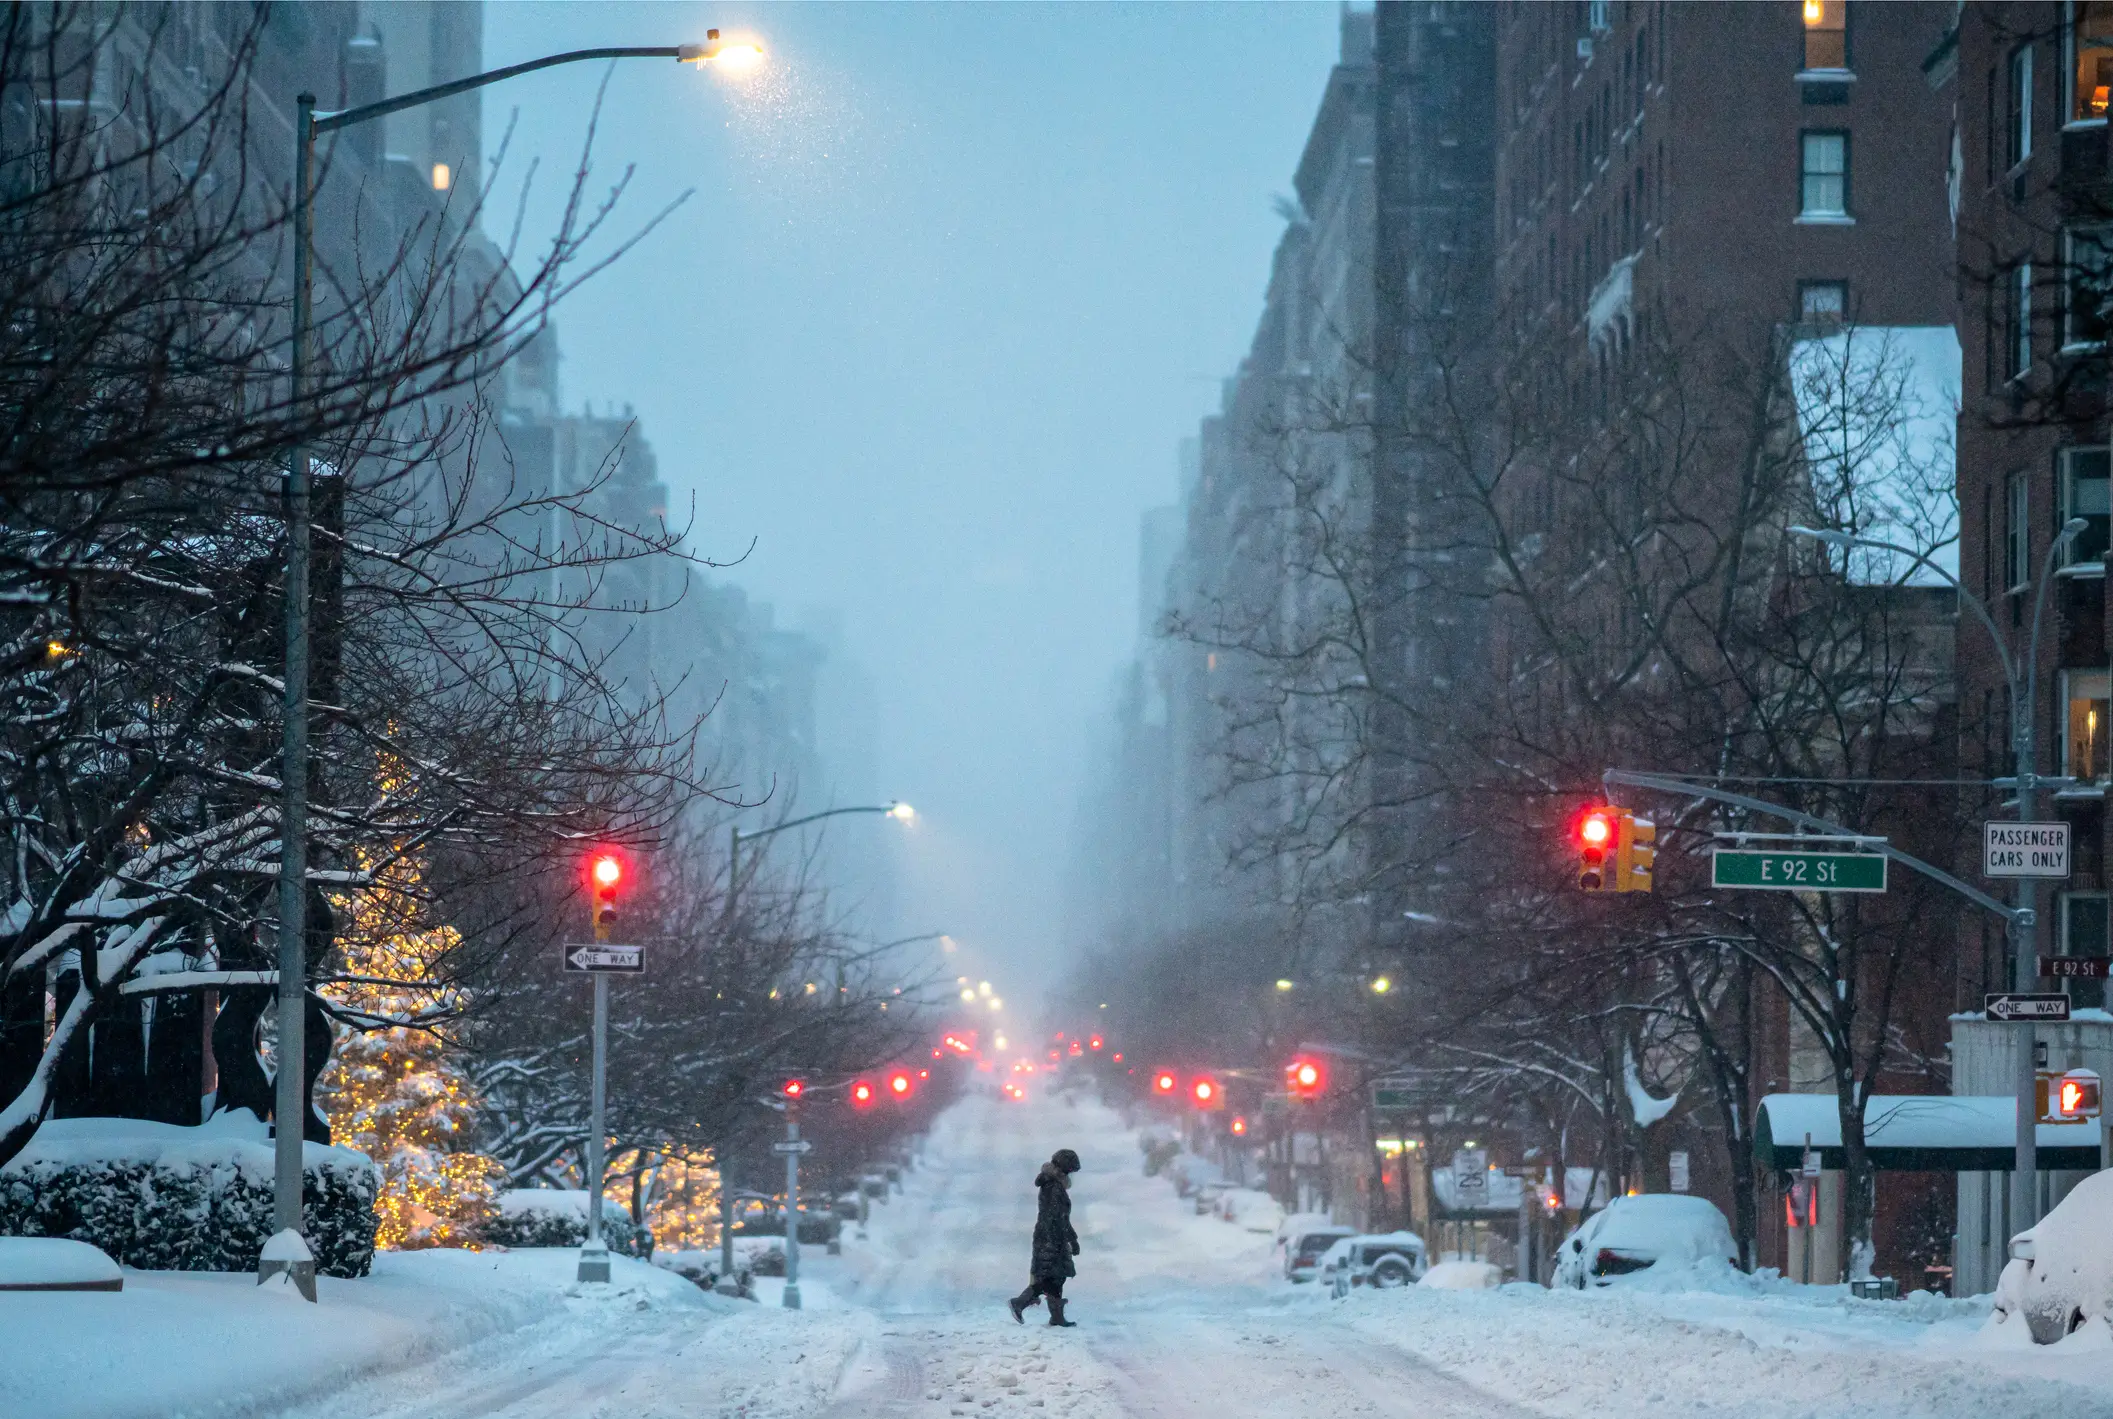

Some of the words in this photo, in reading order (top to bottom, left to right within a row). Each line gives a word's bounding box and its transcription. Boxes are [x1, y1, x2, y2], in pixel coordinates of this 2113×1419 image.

[1990, 830, 2064, 846] PASSENGER
[1990, 851, 2023, 867] CARS
[2032, 851, 2064, 867] ONLY
[1761, 859, 1773, 881] E
[1782, 860, 1807, 882] 92
[1816, 860, 1838, 882] St
[576, 953, 600, 964] ONE
[610, 954, 634, 965] WAY
[2053, 961, 2060, 976] E
[2064, 961, 2078, 976] 92
[2082, 961, 2095, 976] St
[1996, 1002, 2022, 1013] ONE
[2035, 1002, 2062, 1013] WAY
[1459, 1171, 1484, 1188] 25
